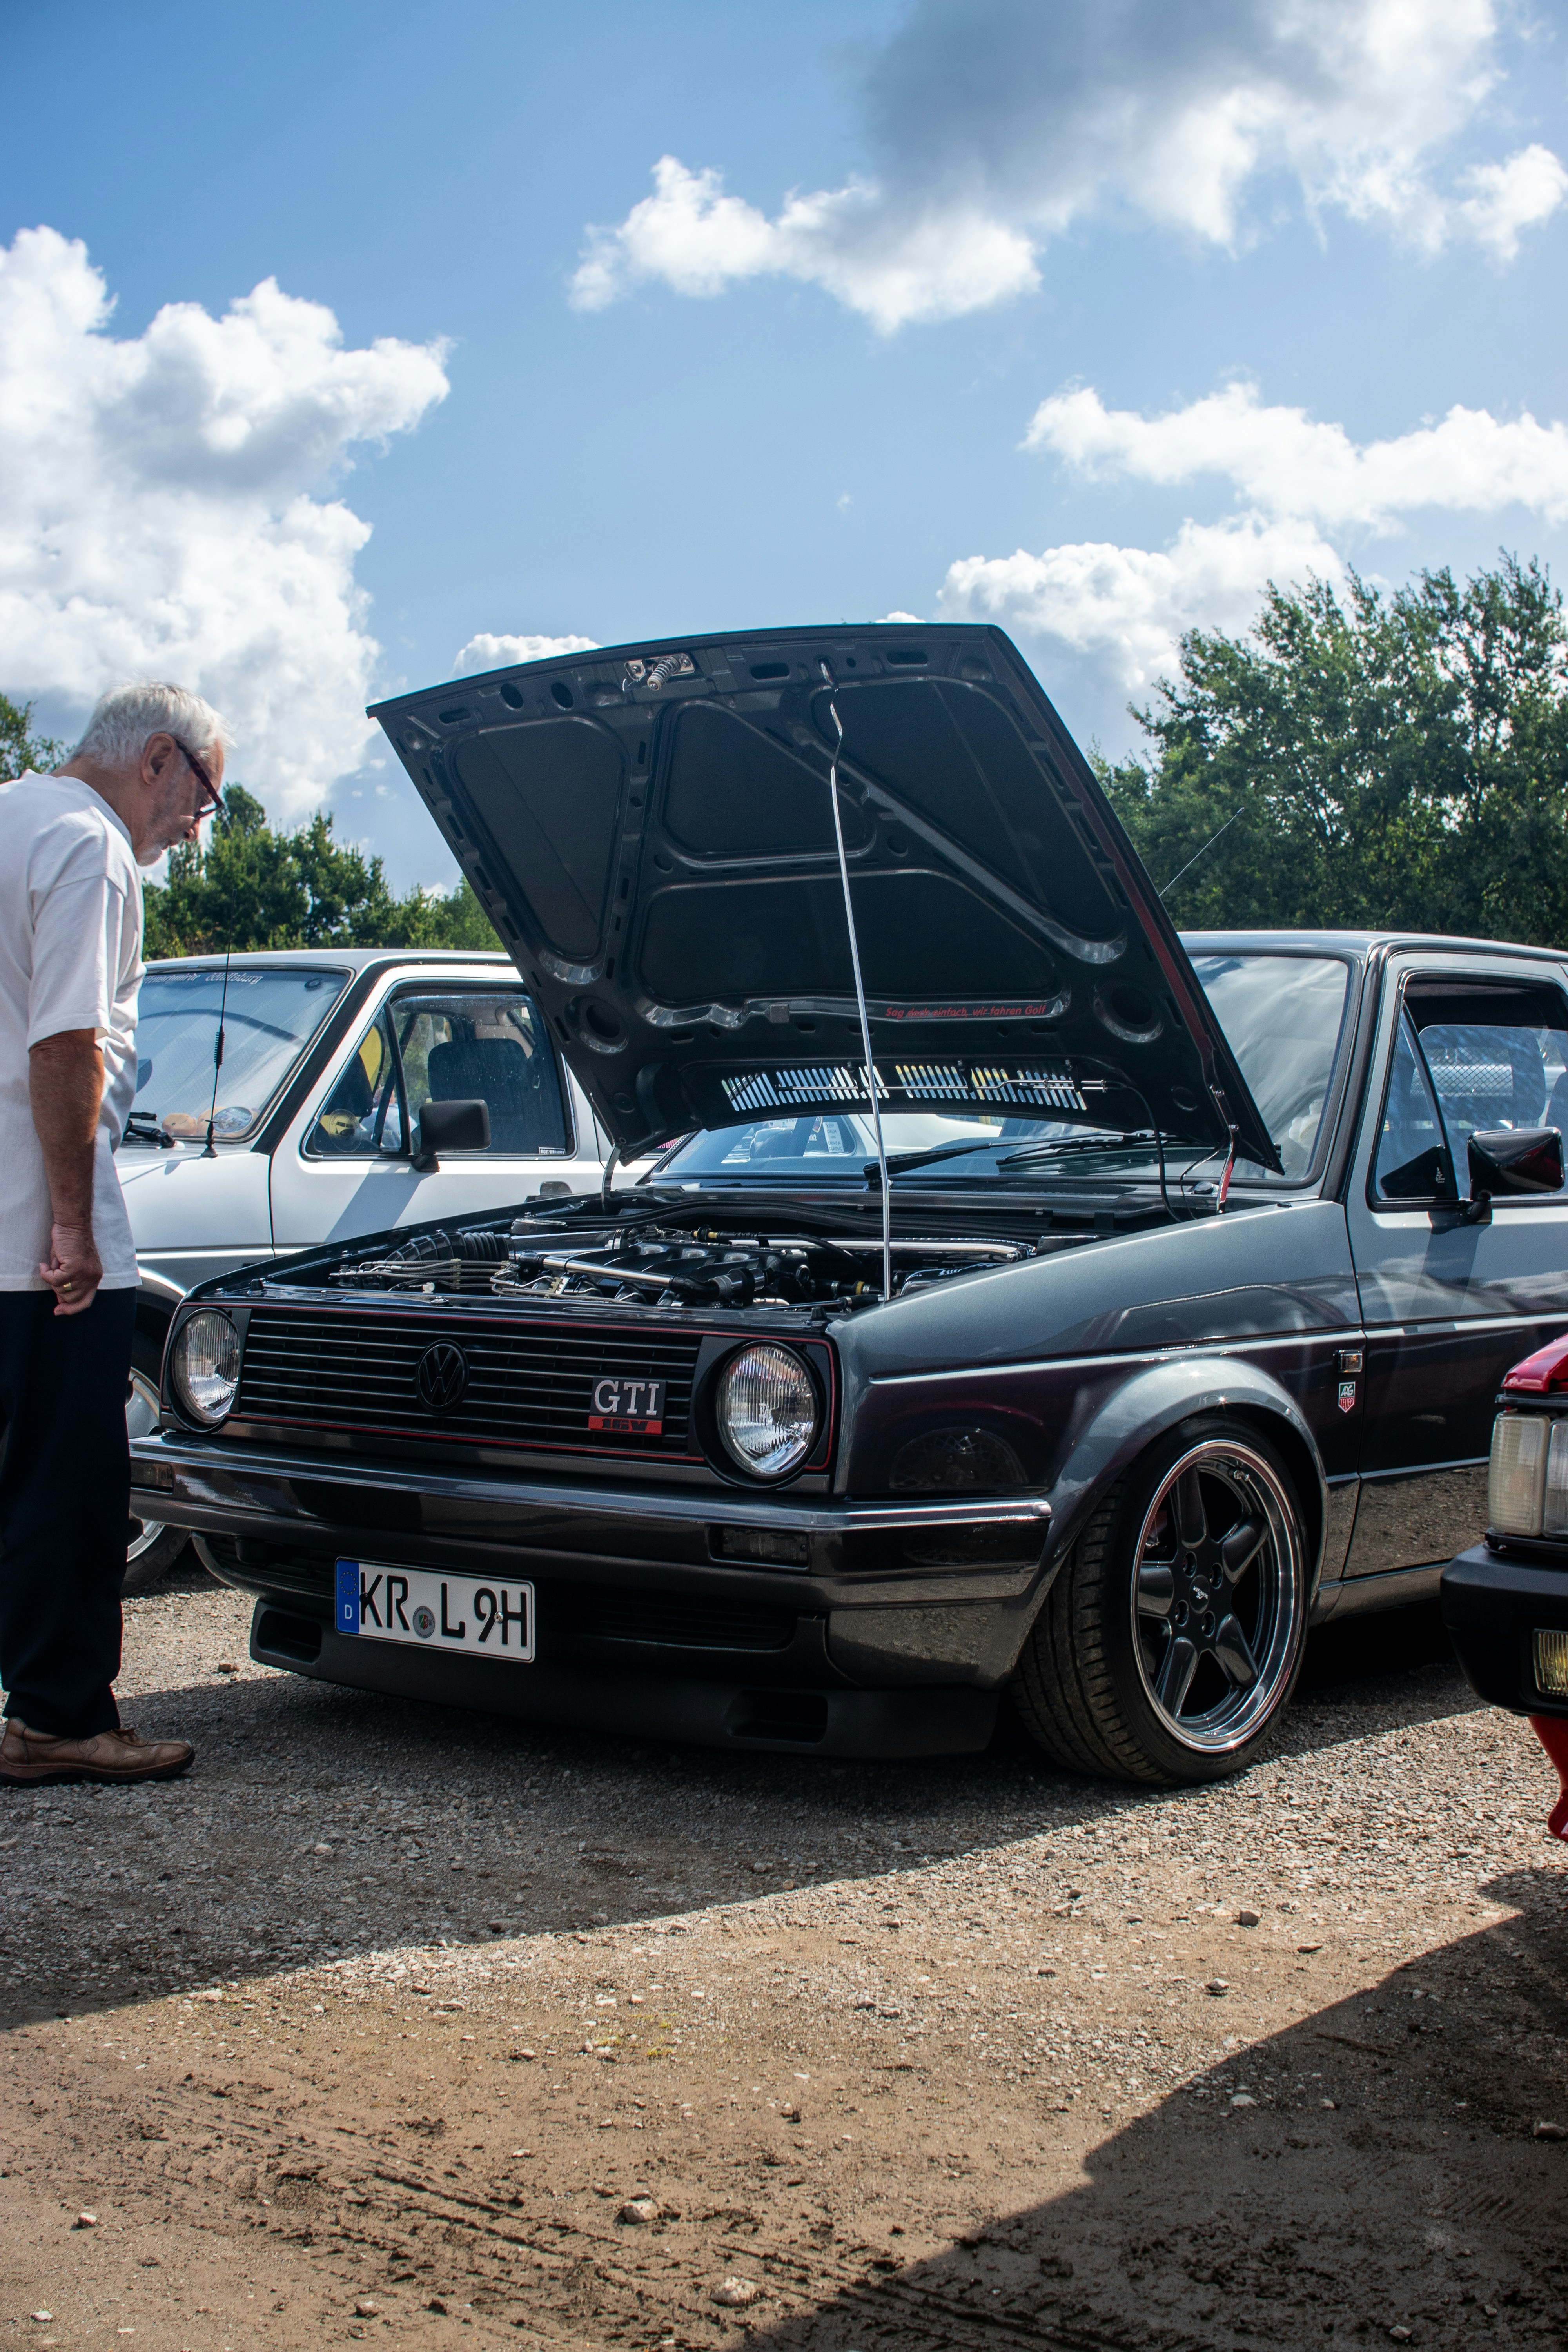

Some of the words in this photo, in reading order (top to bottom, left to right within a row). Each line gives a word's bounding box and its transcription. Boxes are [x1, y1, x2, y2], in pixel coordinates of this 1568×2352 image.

[885, 1007, 904, 1019] Sag
[907, 1007, 929, 1017] doch
[932, 1007, 969, 1018] einfach,
[972, 1007, 987, 1016] wir
[989, 1006, 1022, 1016] fahren
[1025, 1005, 1046, 1015] Golf
[595, 1379, 659, 1416] GTI
[1340, 1397, 1353, 1410] TEUER
[602, 1418, 648, 1432] 16V
[359, 1572, 410, 1631] KR
[344, 1604, 352, 1620] D
